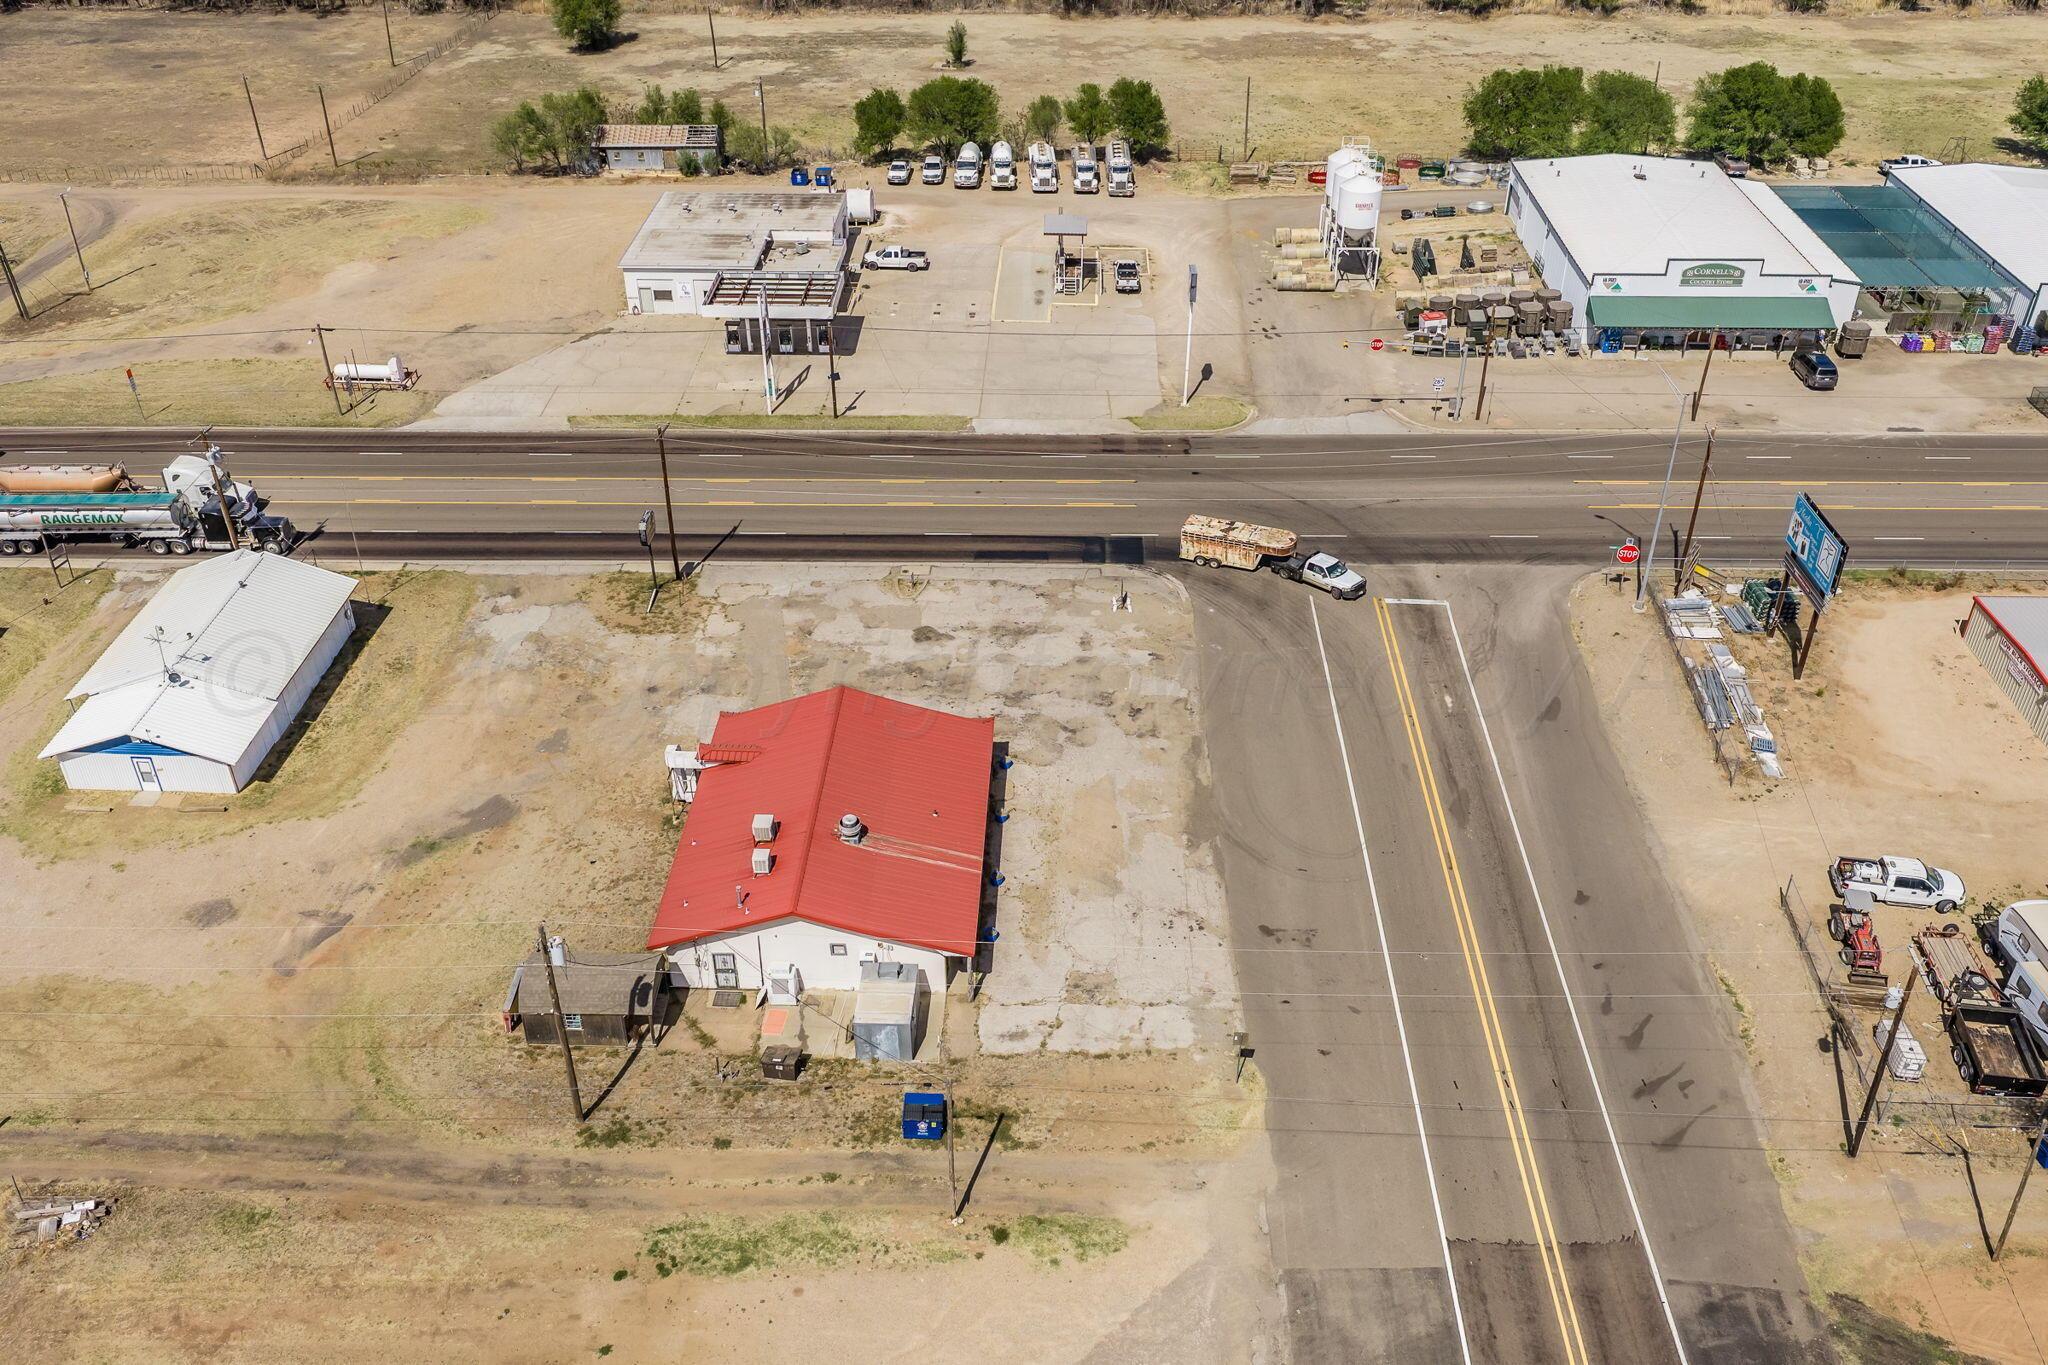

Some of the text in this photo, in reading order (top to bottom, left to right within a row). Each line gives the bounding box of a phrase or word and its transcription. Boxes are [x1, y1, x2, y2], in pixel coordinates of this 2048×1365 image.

[41, 514, 125, 524] RANGEMAX
[1618, 549, 1638, 558] STOP
[2023, 664, 2042, 690] STORAGE
